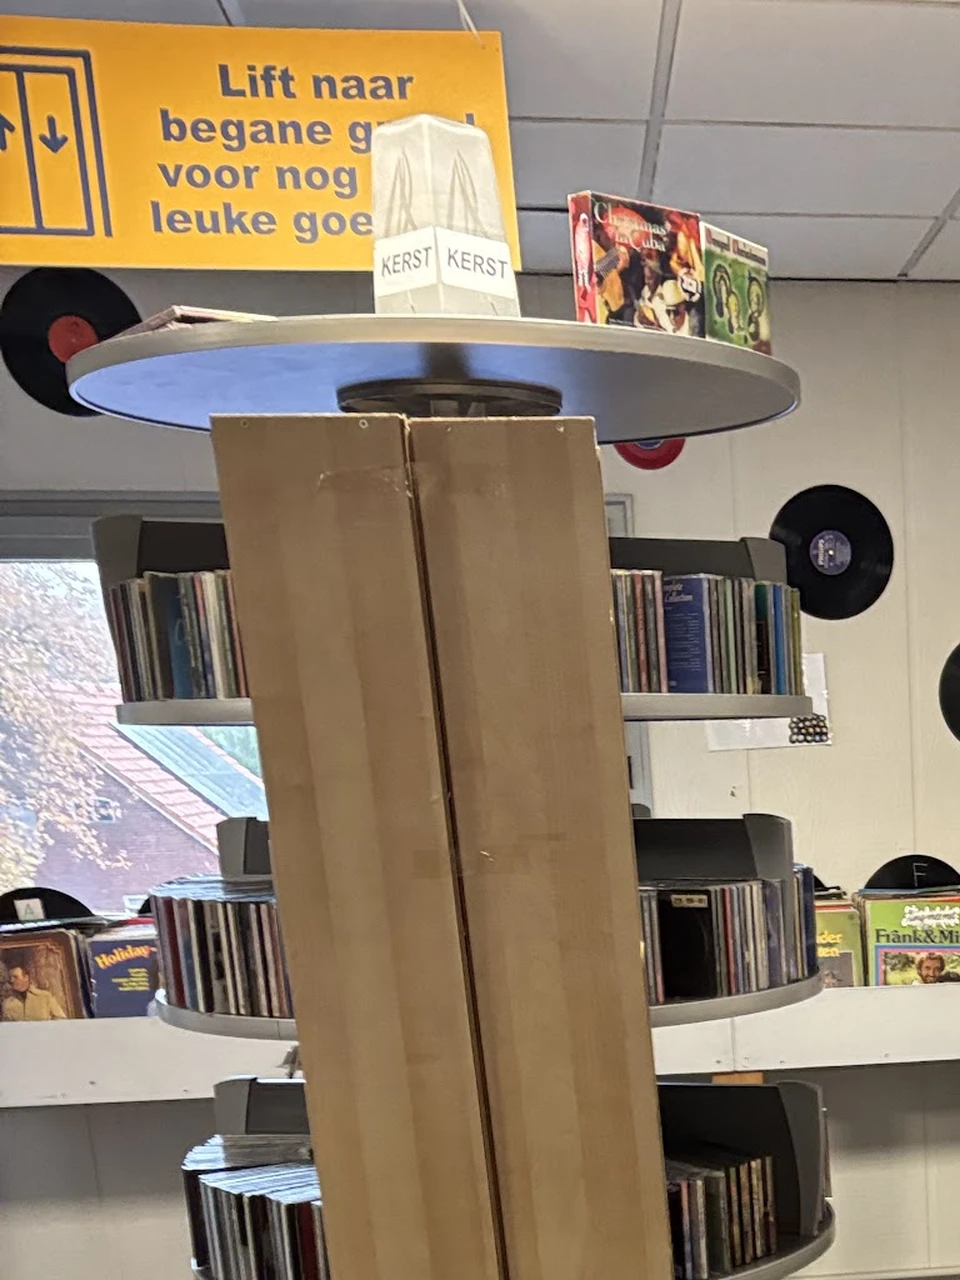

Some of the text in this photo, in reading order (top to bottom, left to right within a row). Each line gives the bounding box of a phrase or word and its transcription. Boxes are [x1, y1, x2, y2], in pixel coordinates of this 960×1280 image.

[217, 63, 414, 100] Lift naar
[159, 107, 332, 152] begane
[157, 163, 359, 200] voor nog
[150, 200, 375, 245] leuke goe
[380, 246, 433, 278] KERST
[446, 247, 509, 280] KERST
[912, 862, 928, 887] F
